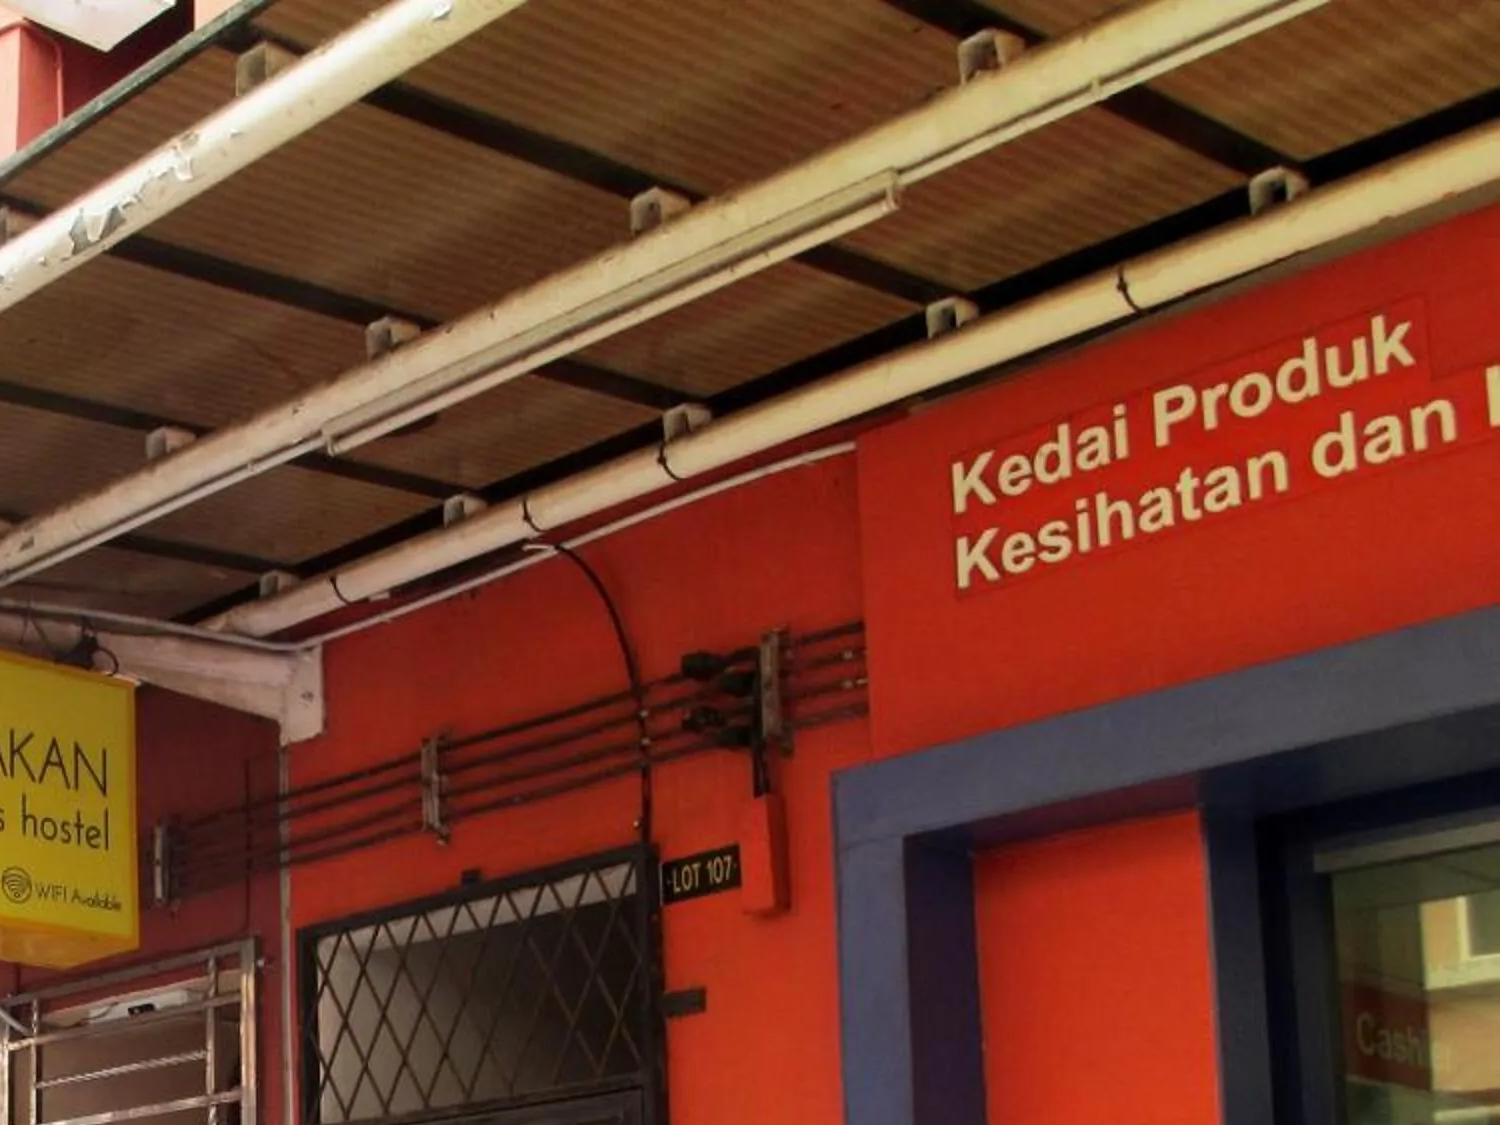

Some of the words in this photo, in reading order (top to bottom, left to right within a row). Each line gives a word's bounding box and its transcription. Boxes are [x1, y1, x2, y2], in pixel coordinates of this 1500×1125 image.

[952, 403, 1129, 513] Kedai
[1153, 314, 1416, 448] Produk
[955, 448, 1289, 590] Kesihatan
[1311, 397, 1457, 479] dan
[21, 799, 111, 852] hostel
[672, 862, 702, 893] LOT
[706, 854, 733, 885] 107
[70, 889, 122, 913] Available
